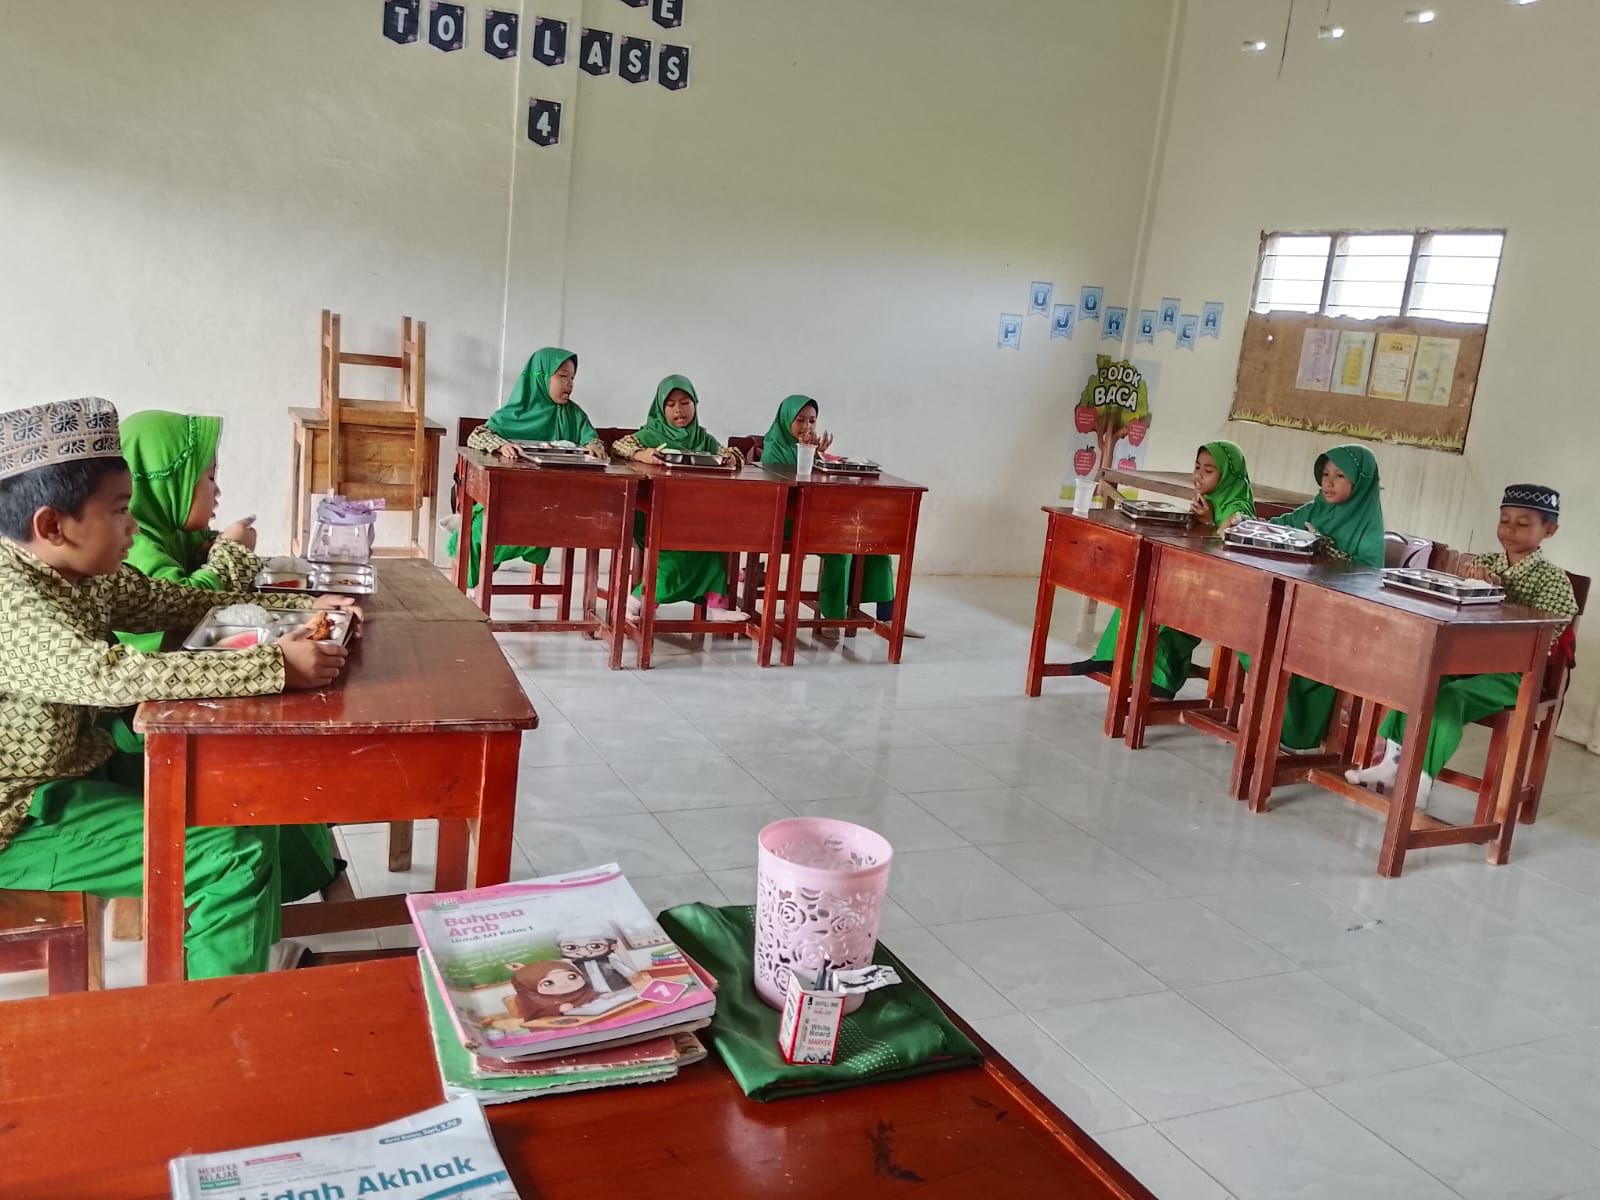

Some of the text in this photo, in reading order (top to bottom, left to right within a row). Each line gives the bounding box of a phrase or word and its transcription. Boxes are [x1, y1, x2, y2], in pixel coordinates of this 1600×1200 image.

[394, 6, 681, 81] TO CLASS
[535, 111, 552, 137] 4
[1094, 385, 1138, 411] BACA
[443, 909, 524, 927] Bahasa
[448, 922, 500, 937] Arab
[809, 1030, 831, 1038] Board
[811, 1024, 831, 1032] White
[358, 1156, 477, 1195] Akhlak
